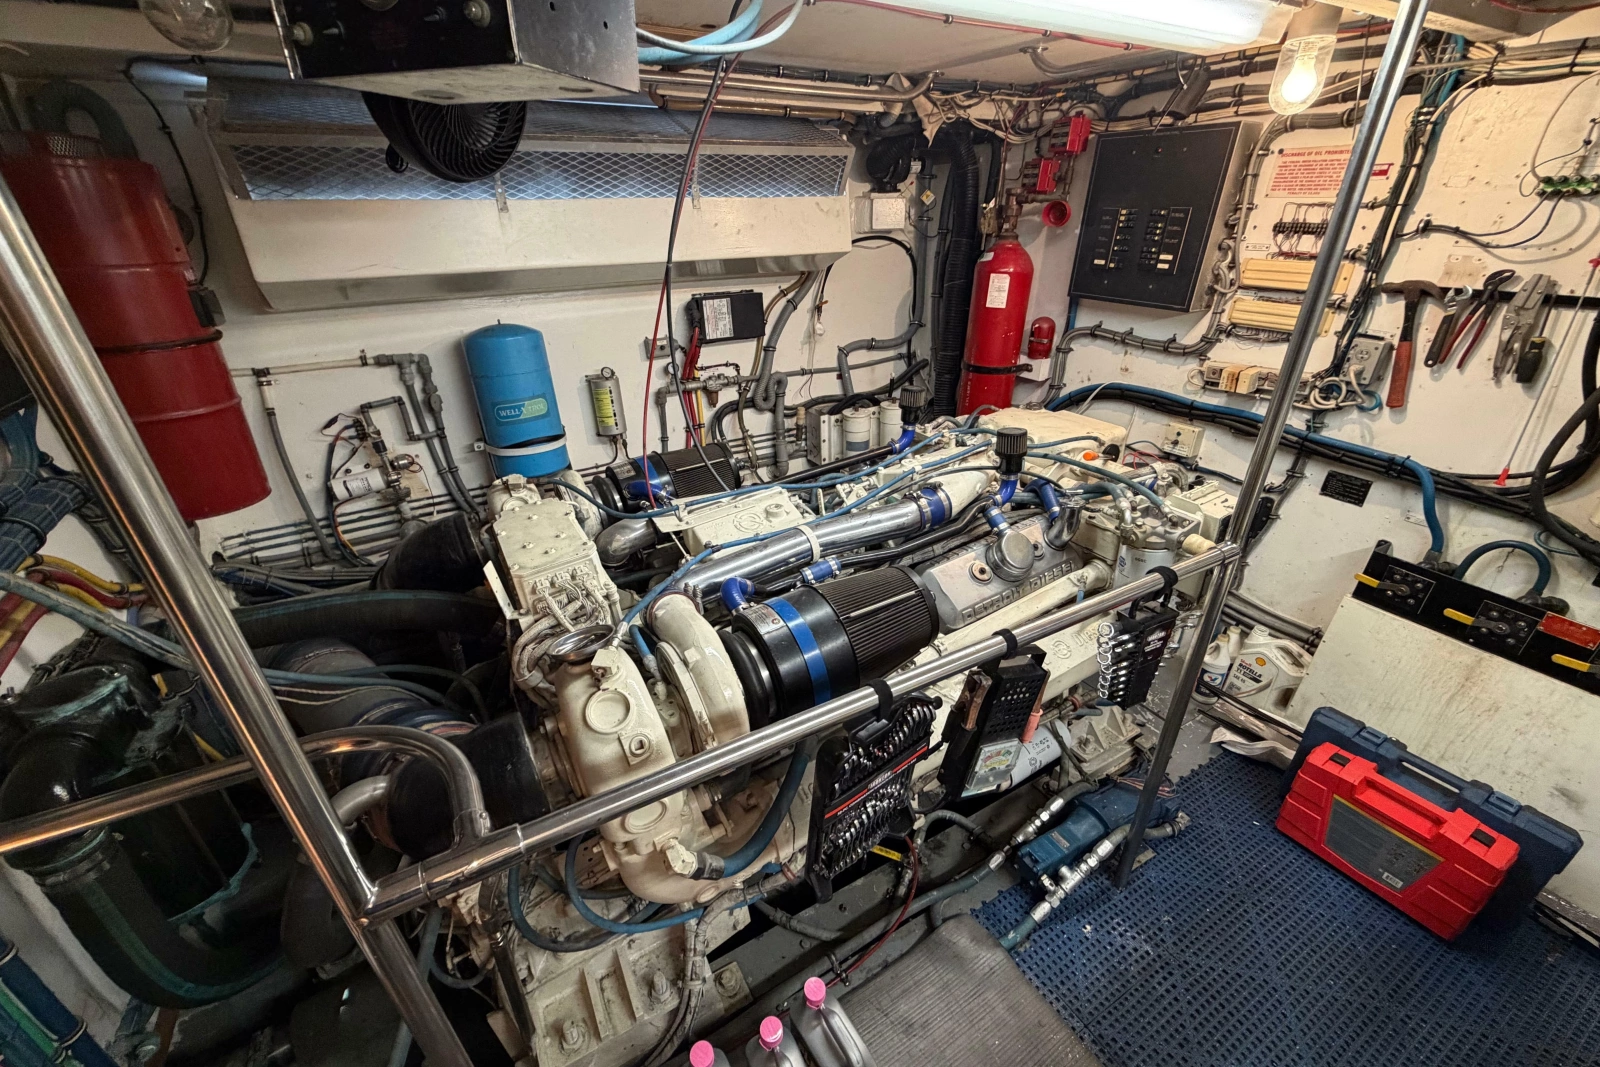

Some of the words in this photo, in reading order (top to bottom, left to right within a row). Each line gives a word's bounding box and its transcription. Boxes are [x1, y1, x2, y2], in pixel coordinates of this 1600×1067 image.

[962, 586, 1024, 624] DETROIT
[1030, 560, 1074, 592] DIESEL
[1238, 662, 1262, 679] ROTELLA
